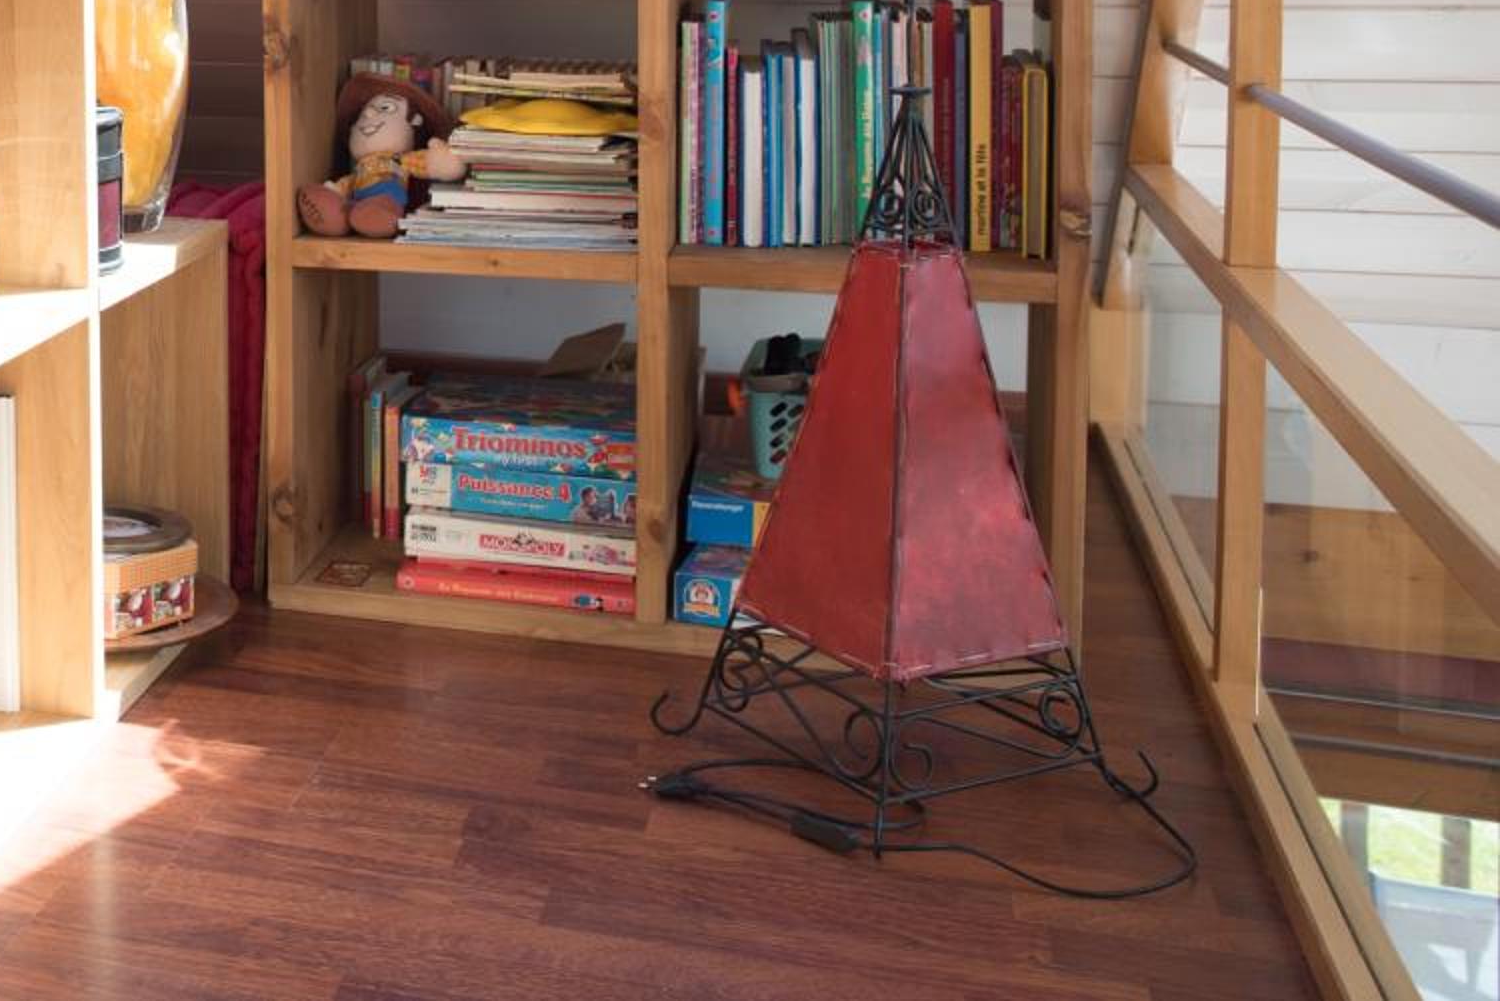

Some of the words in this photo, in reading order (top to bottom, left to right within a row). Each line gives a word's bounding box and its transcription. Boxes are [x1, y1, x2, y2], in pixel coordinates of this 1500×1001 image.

[452, 425, 585, 459] Triominos
[457, 474, 551, 500] Puissance
[557, 483, 570, 501] 4
